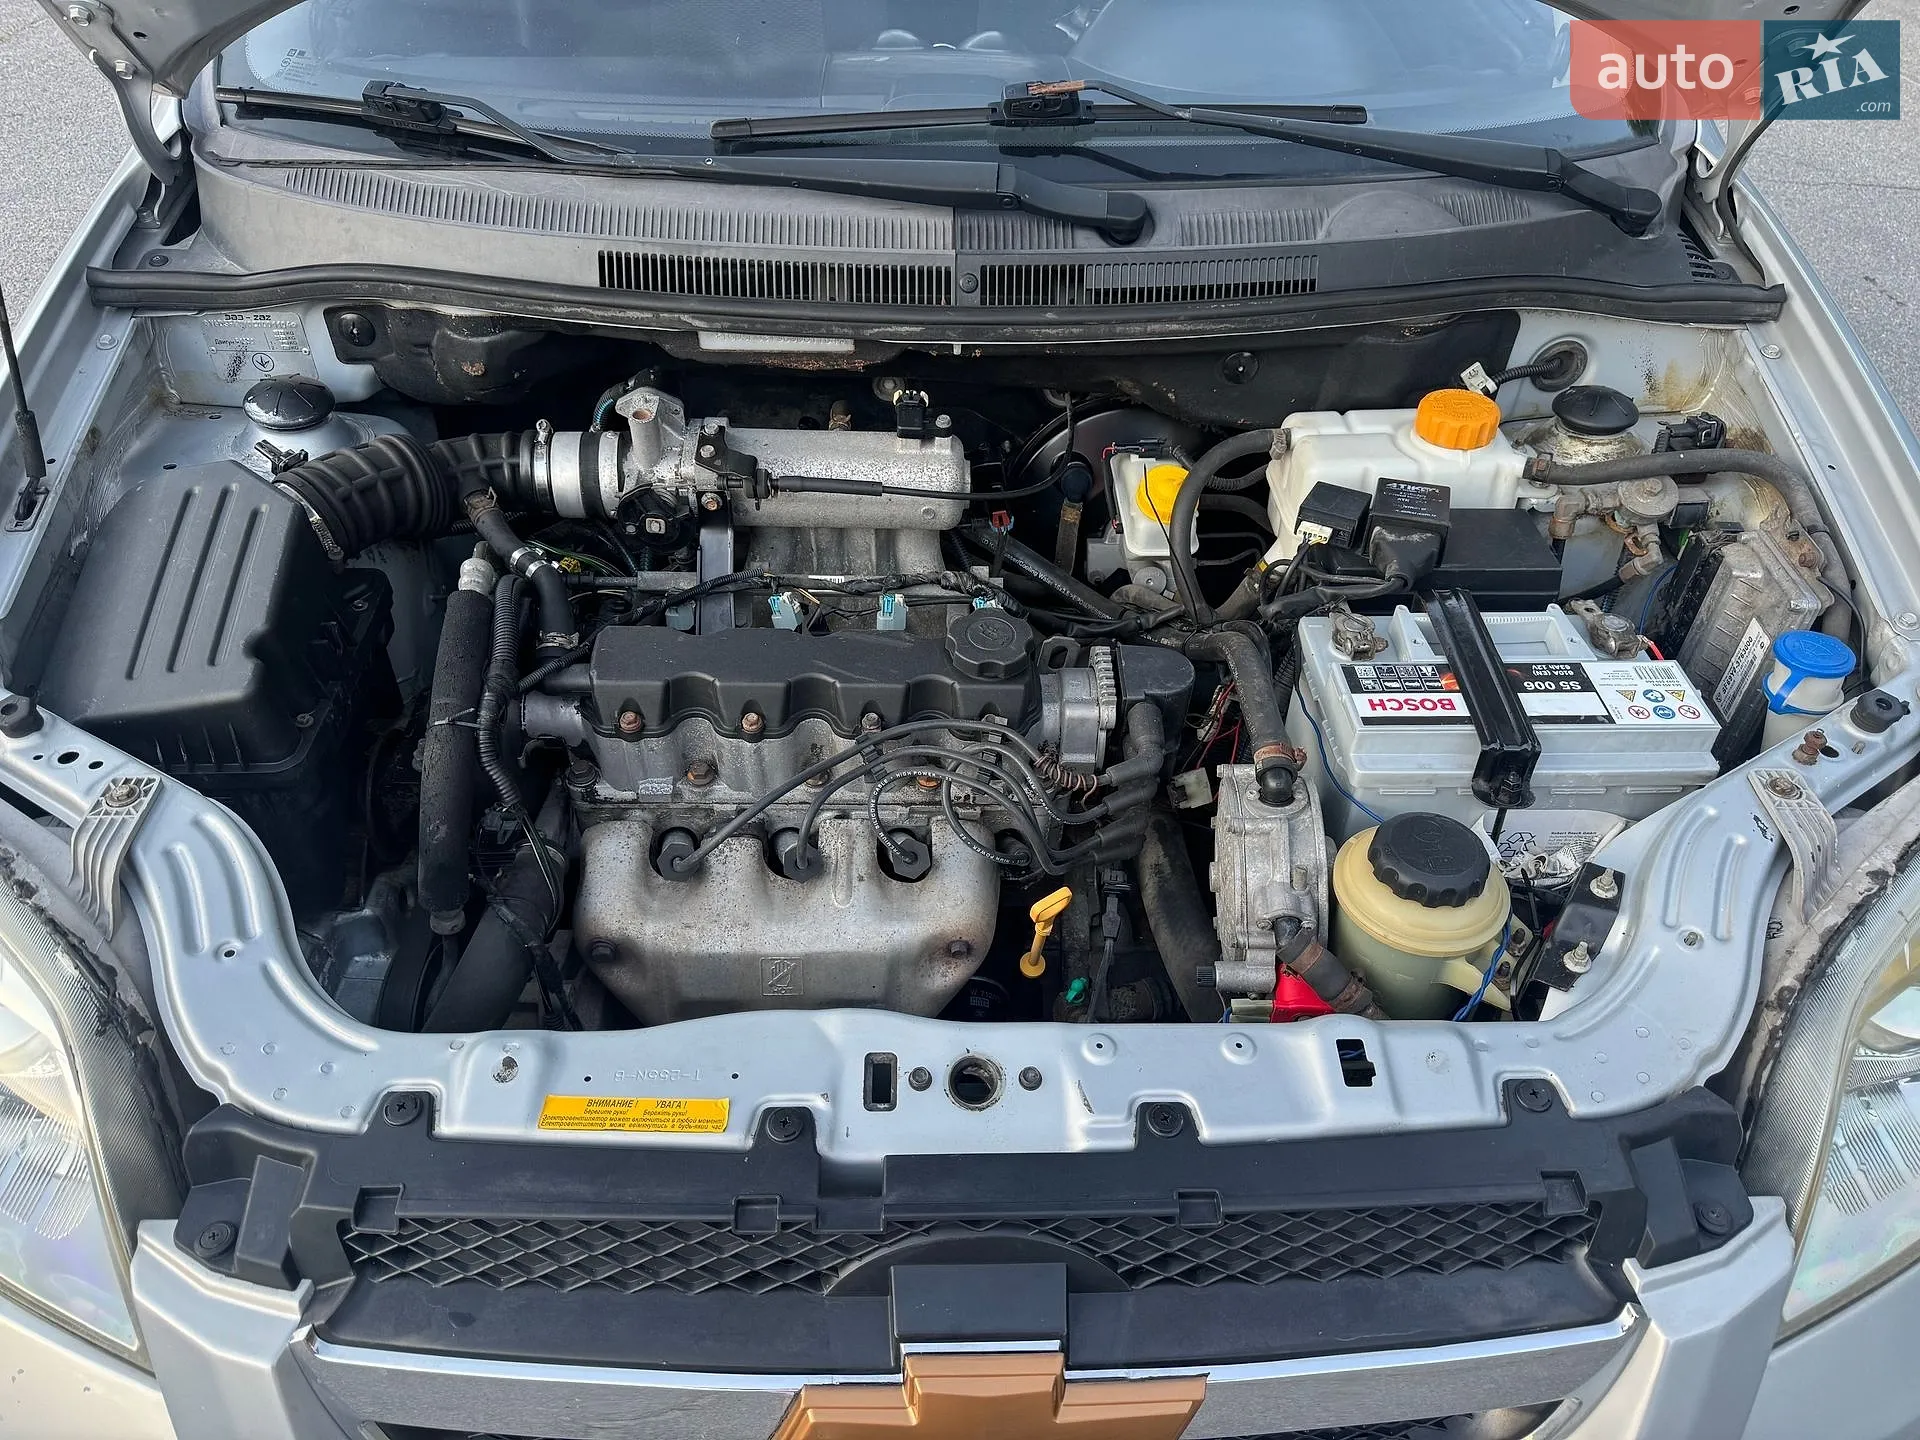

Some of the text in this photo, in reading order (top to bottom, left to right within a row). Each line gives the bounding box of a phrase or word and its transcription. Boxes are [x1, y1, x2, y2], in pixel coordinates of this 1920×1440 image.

[1522, 680, 1583, 691] S5 006
[1368, 698, 1457, 711] BOSCH
[586, 1099, 634, 1109] ВНИМАНИЕ
[655, 1099, 681, 1109] УВАГА
